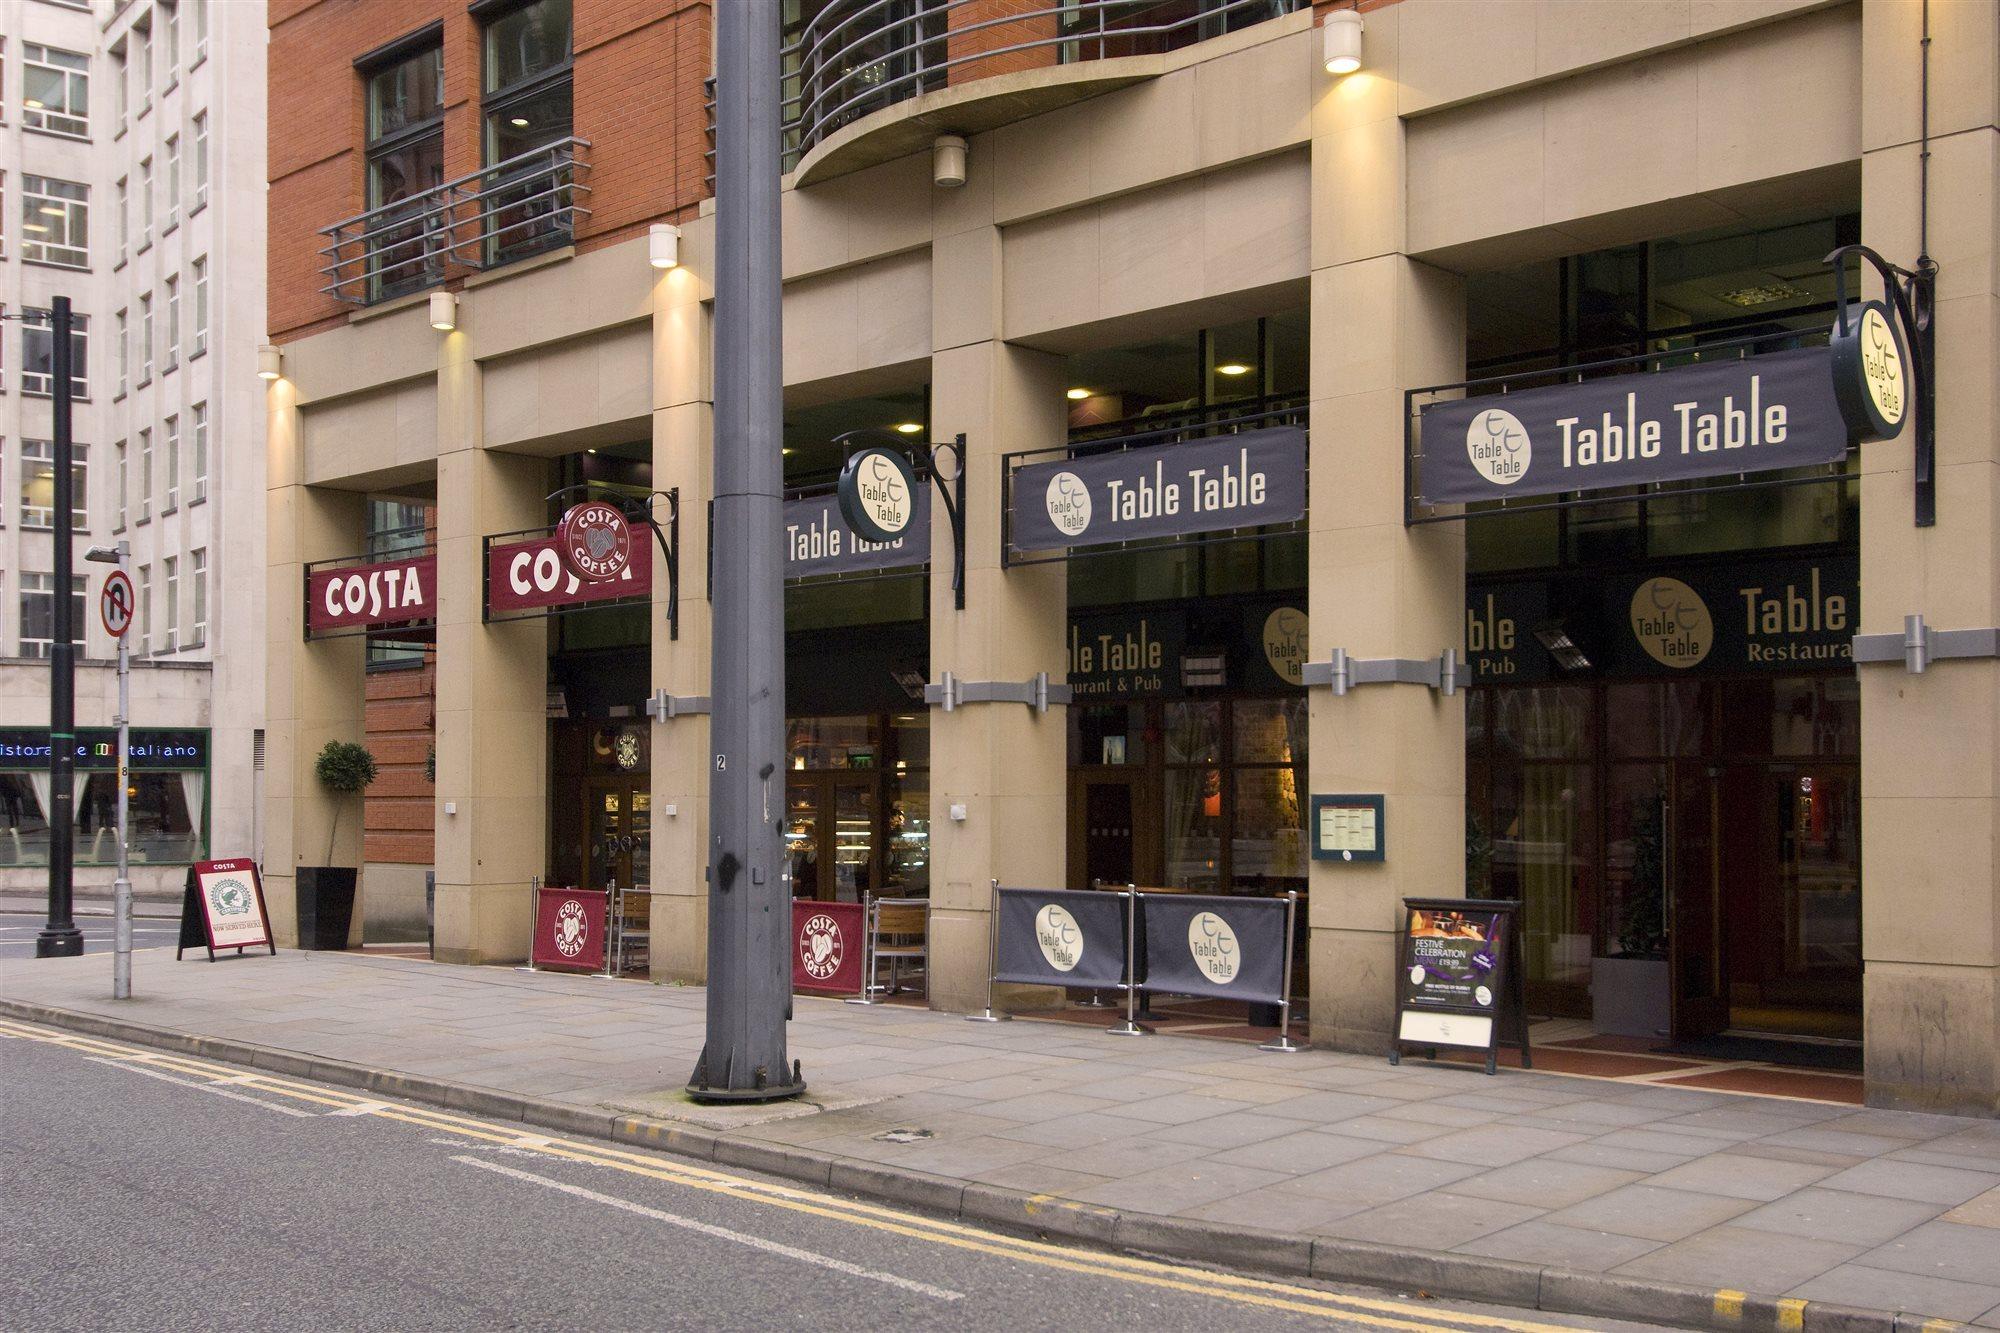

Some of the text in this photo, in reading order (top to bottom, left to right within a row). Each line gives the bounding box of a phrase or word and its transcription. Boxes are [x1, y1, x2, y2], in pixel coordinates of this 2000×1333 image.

[1865, 351, 1885, 381] Table
[1878, 382, 1899, 411] Table
[1556, 375, 1787, 467] Table Table
[1472, 437, 1501, 459] Table
[1490, 453, 1520, 475] Table
[862, 482, 887, 502] Table
[1107, 448, 1266, 521] Table Table
[877, 503, 901, 522] Table
[1050, 496, 1071, 513] Table
[578, 510, 620, 531] COSTA
[1063, 509, 1084, 527] Table
[787, 509, 840, 561] Table
[575, 547, 624, 574] COFFEE
[326, 567, 423, 617] COSTA
[1740, 568, 1846, 635] Table
[1468, 594, 1515, 651] ble
[1637, 612, 1675, 635] Table
[1098, 620, 1161, 672] Table
[1268, 637, 1296, 658] Table
[1660, 632, 1699, 656] Table
[1748, 642, 1853, 661] Restaura
[1480, 657, 1515, 675] Pub
[1074, 674, 1161, 694] urant & Pub
[0, 743, 197, 756] istorae taliano
[717, 756, 725, 770] 2
[560, 903, 583, 919] COSTA
[806, 917, 837, 937] COSTA
[557, 934, 584, 954] COFFEE
[1040, 929, 1060, 946] Table
[1193, 938, 1217, 956] Table
[1415, 939, 1445, 948] FESTIVE
[1053, 946, 1073, 963] Table
[1414, 947, 1467, 959] CELEBRATION
[804, 952, 840, 977] COFFEE
[1208, 956, 1232, 974] Table
